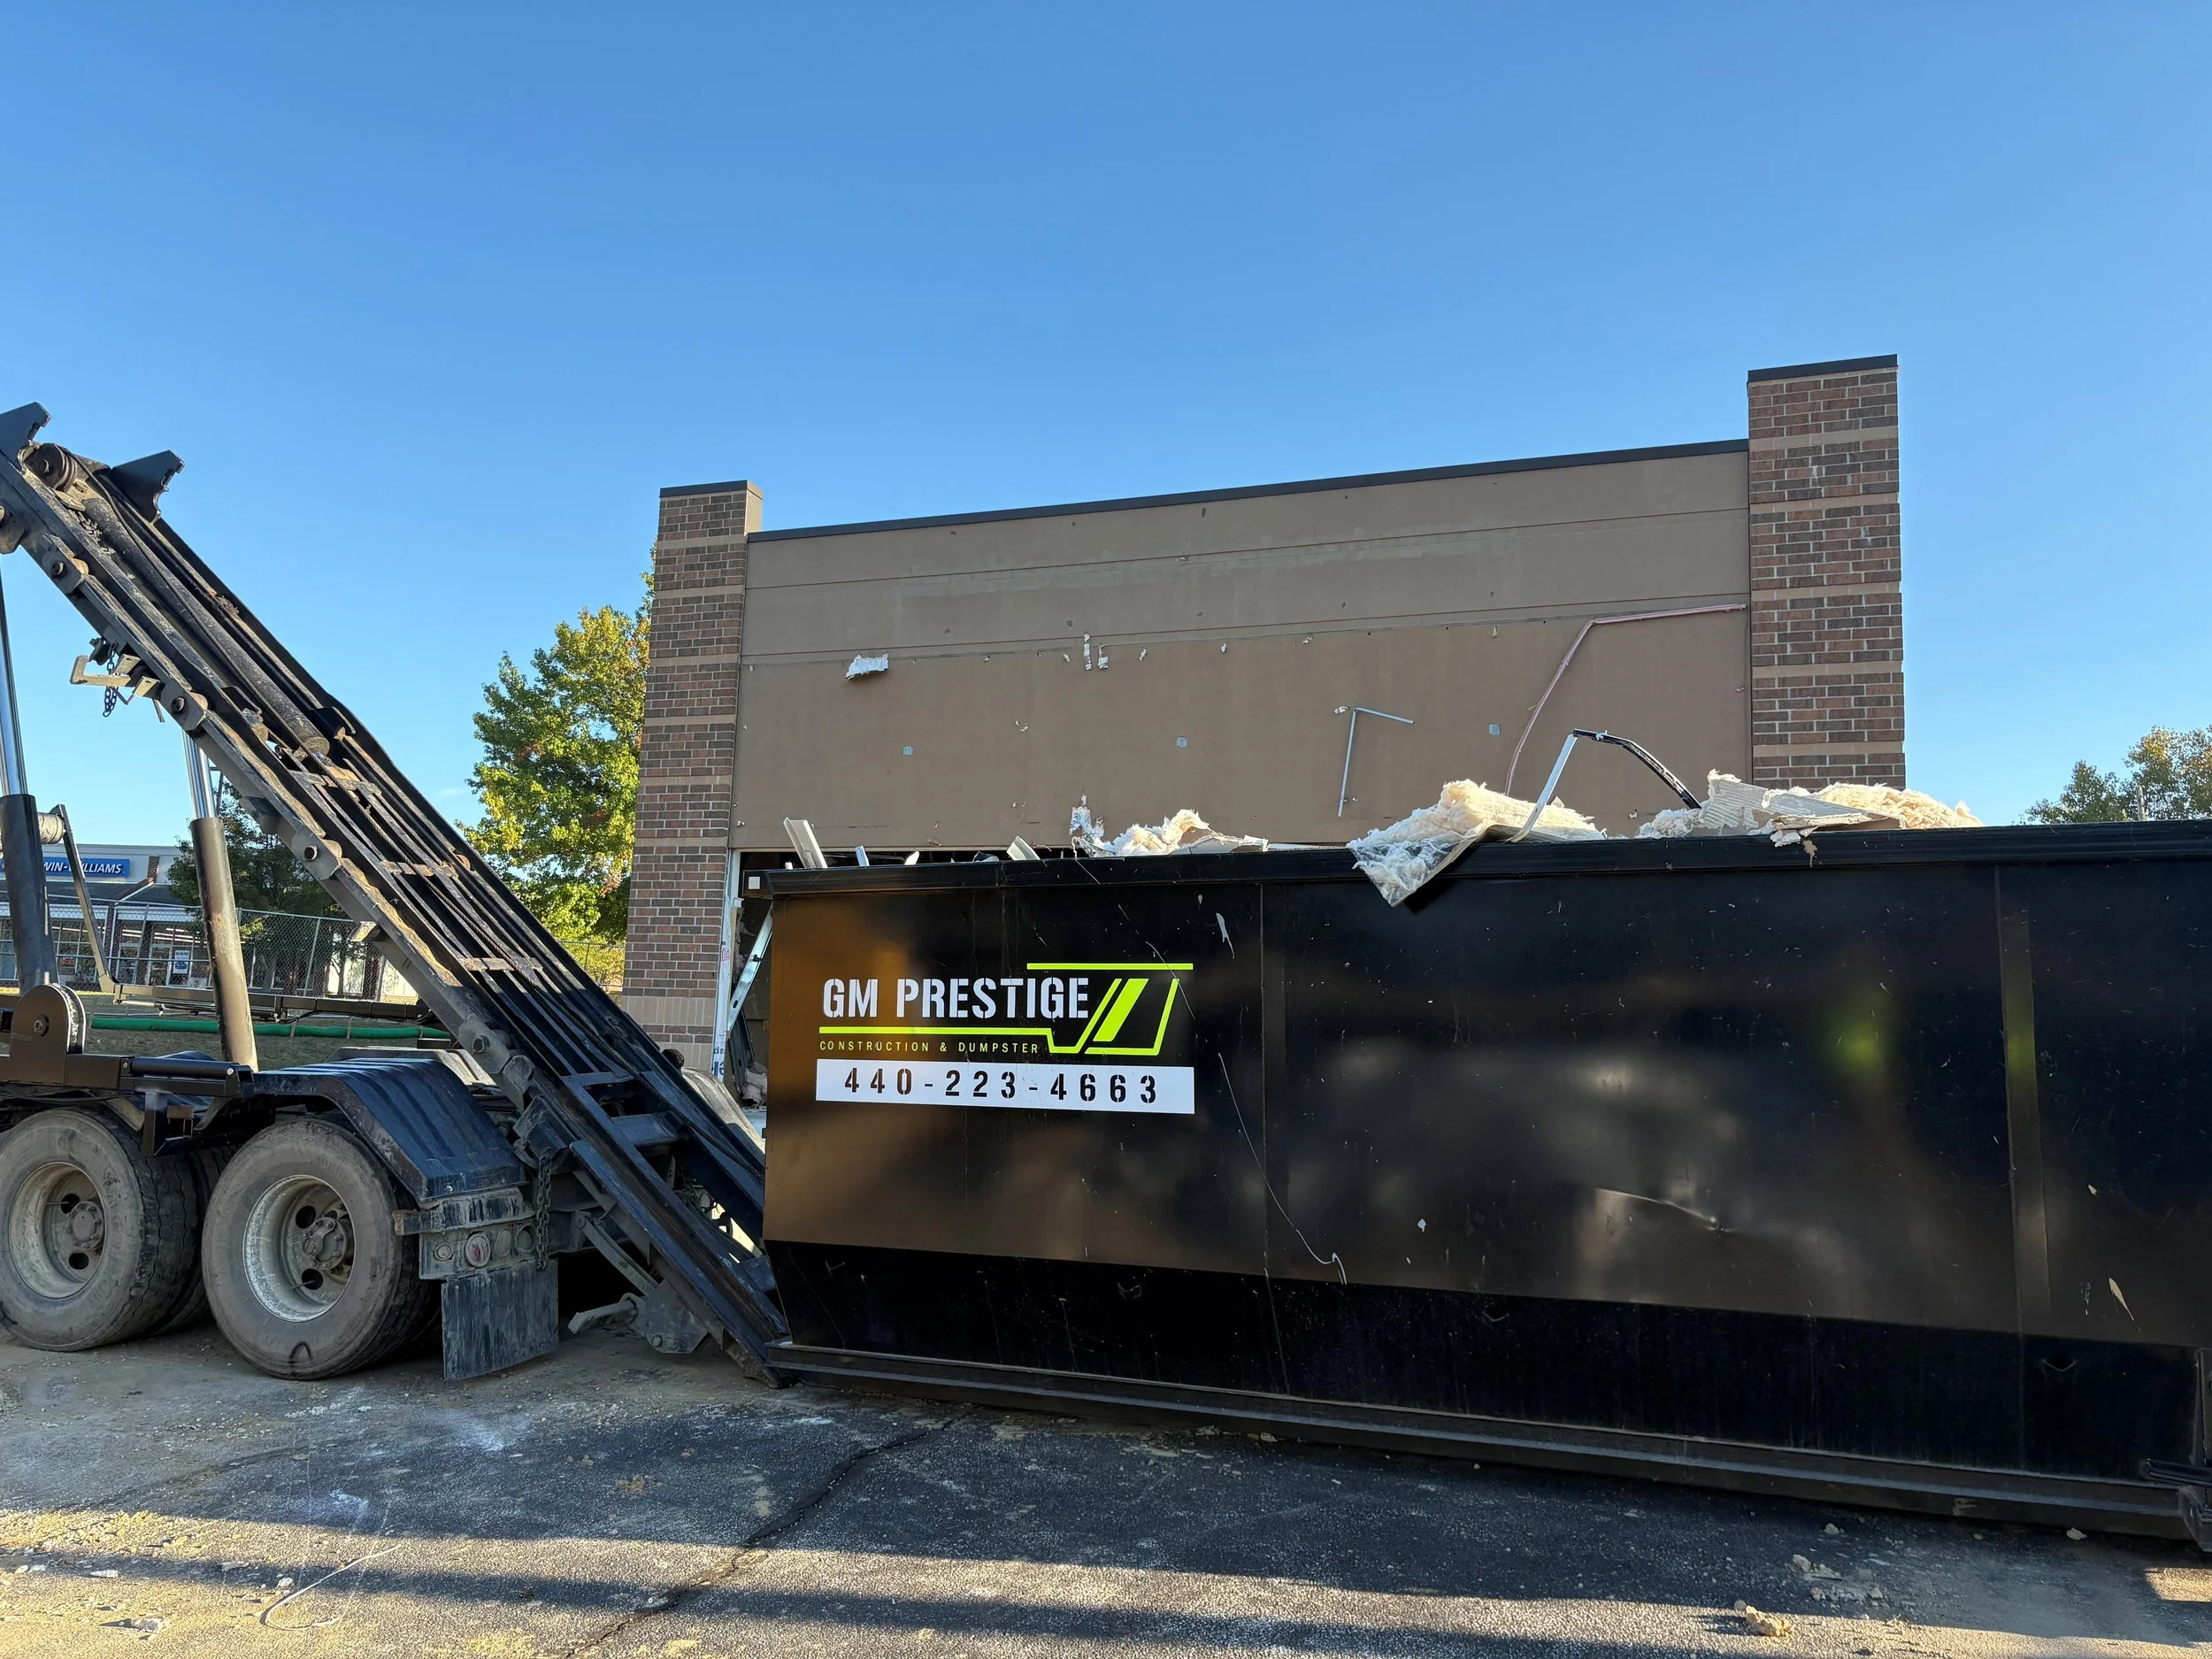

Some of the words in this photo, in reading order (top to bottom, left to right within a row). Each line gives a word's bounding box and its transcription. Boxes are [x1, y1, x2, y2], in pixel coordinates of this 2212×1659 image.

[823, 978, 879, 1018] GM
[896, 978, 1089, 1019] PRESTIGE
[819, 1041, 929, 1053] CONSTRUCTION
[939, 1042, 948, 1053] &
[958, 1042, 1039, 1054] DUMPSTER
[844, 1067, 1156, 1103] 440-223-4663
